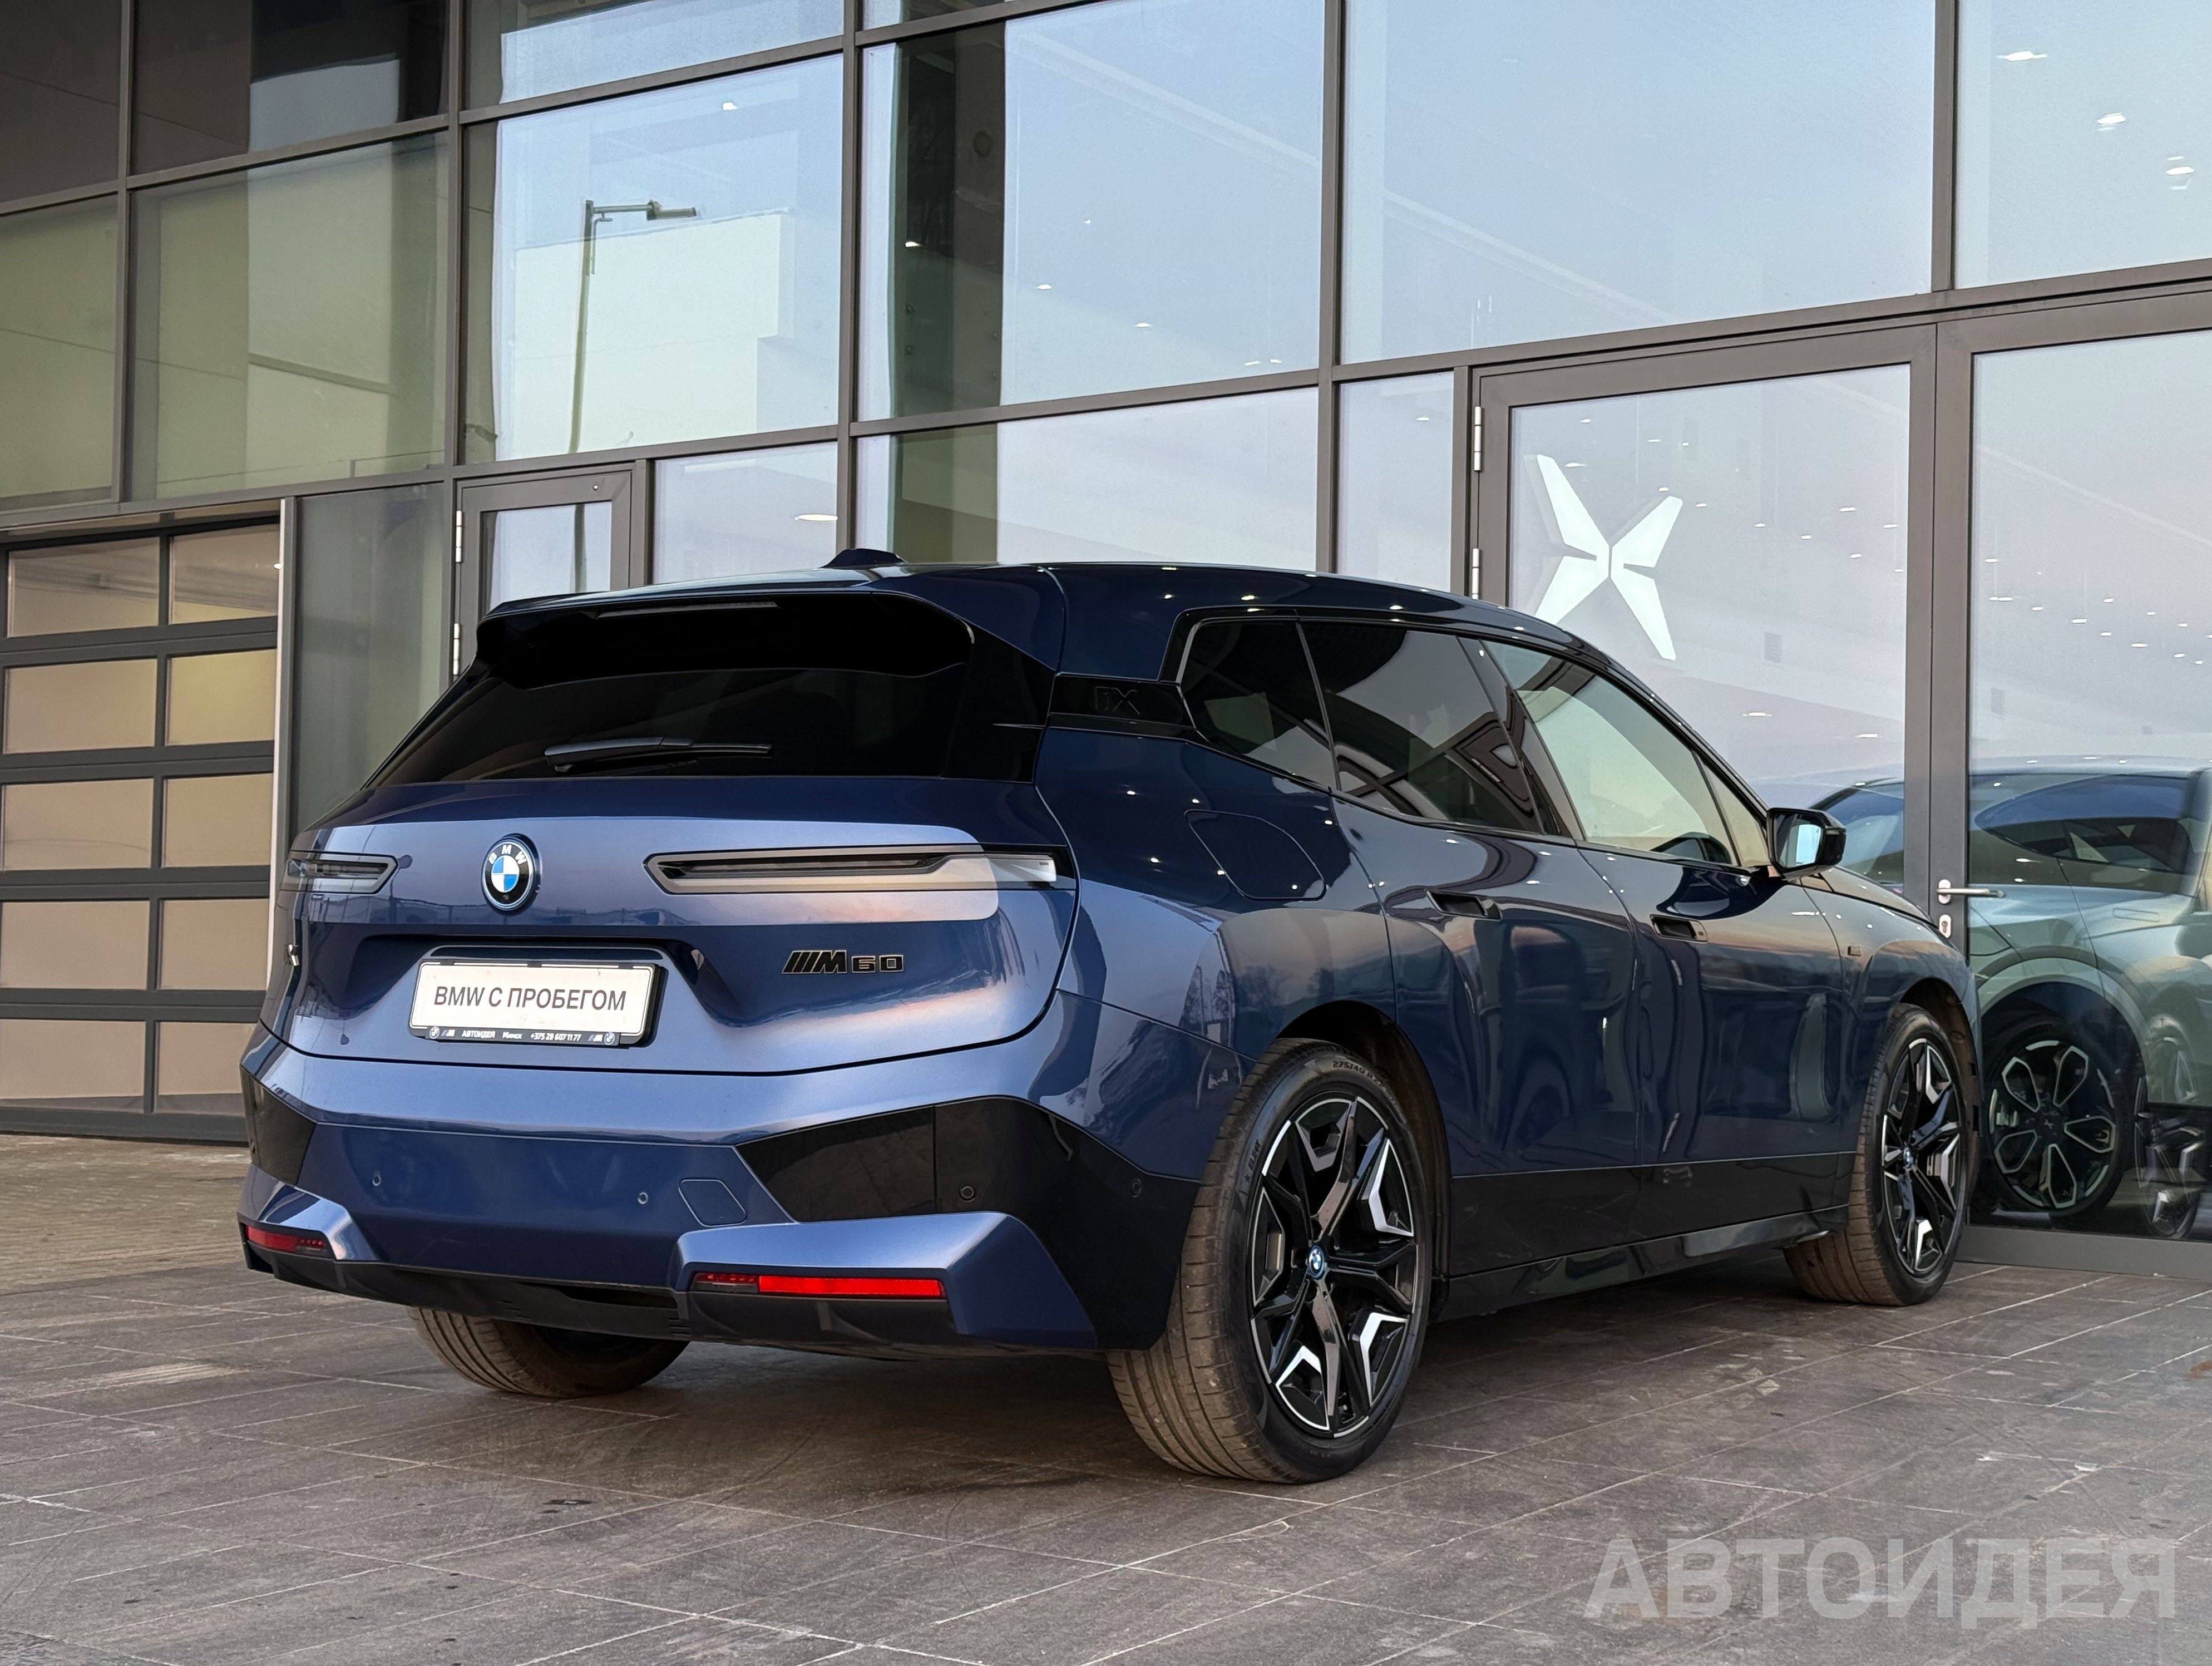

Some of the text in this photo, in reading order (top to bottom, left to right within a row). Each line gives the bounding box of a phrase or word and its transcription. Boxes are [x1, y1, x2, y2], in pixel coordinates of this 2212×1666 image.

[488, 844, 527, 865] BMW
[434, 986, 627, 1011] BMW С ПРОБЕГОМ
